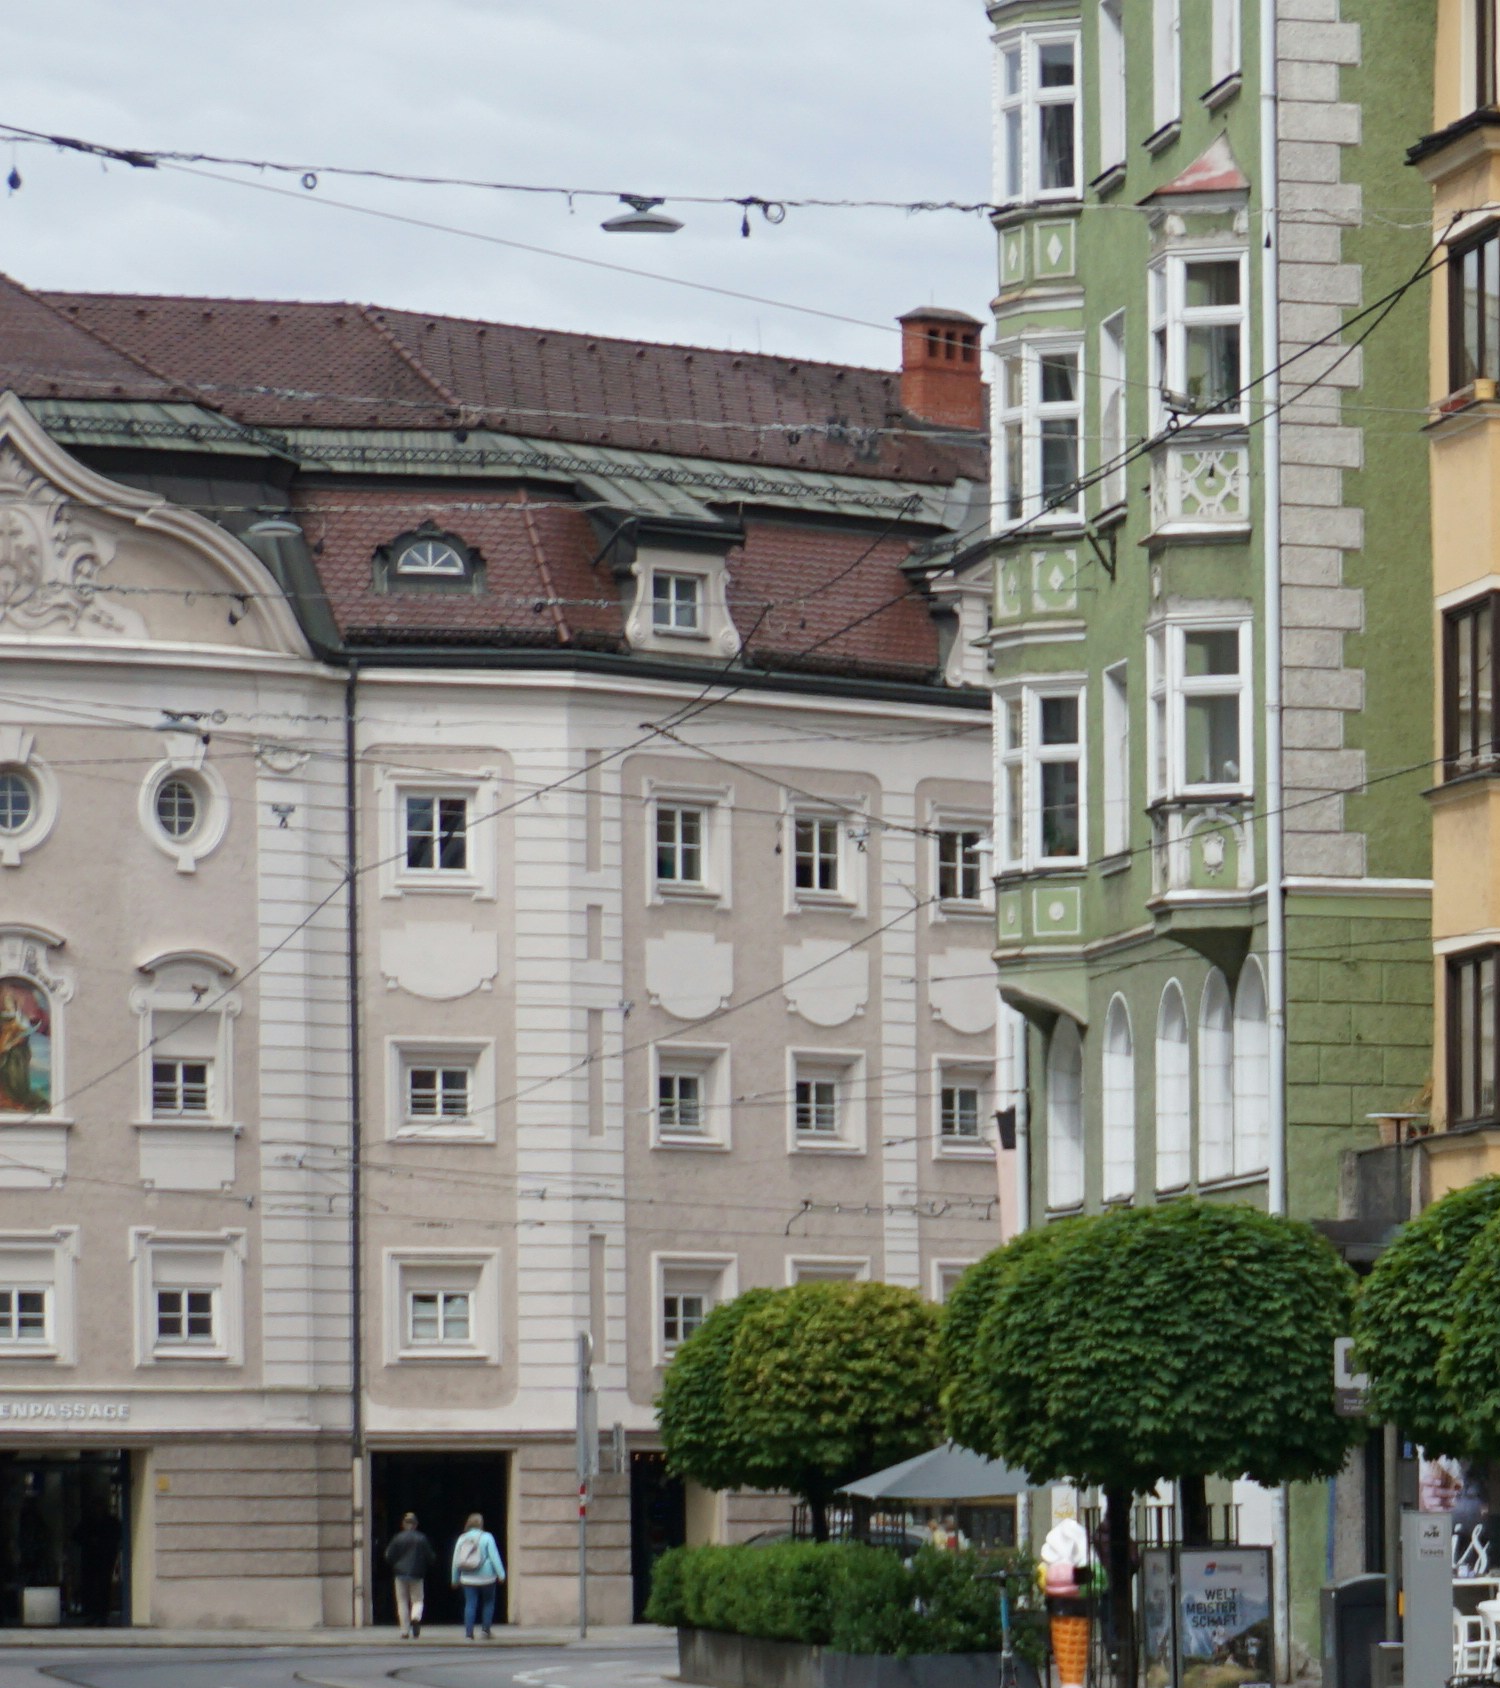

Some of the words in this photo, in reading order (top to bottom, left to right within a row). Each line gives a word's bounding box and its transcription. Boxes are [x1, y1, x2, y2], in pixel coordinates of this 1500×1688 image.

[0, 1402, 130, 1421] ENPASSAGE
[1205, 1588, 1237, 1600] WELT
[1186, 1603, 1237, 1615] MEISTER
[1192, 1615, 1237, 1627] SCHAFT
